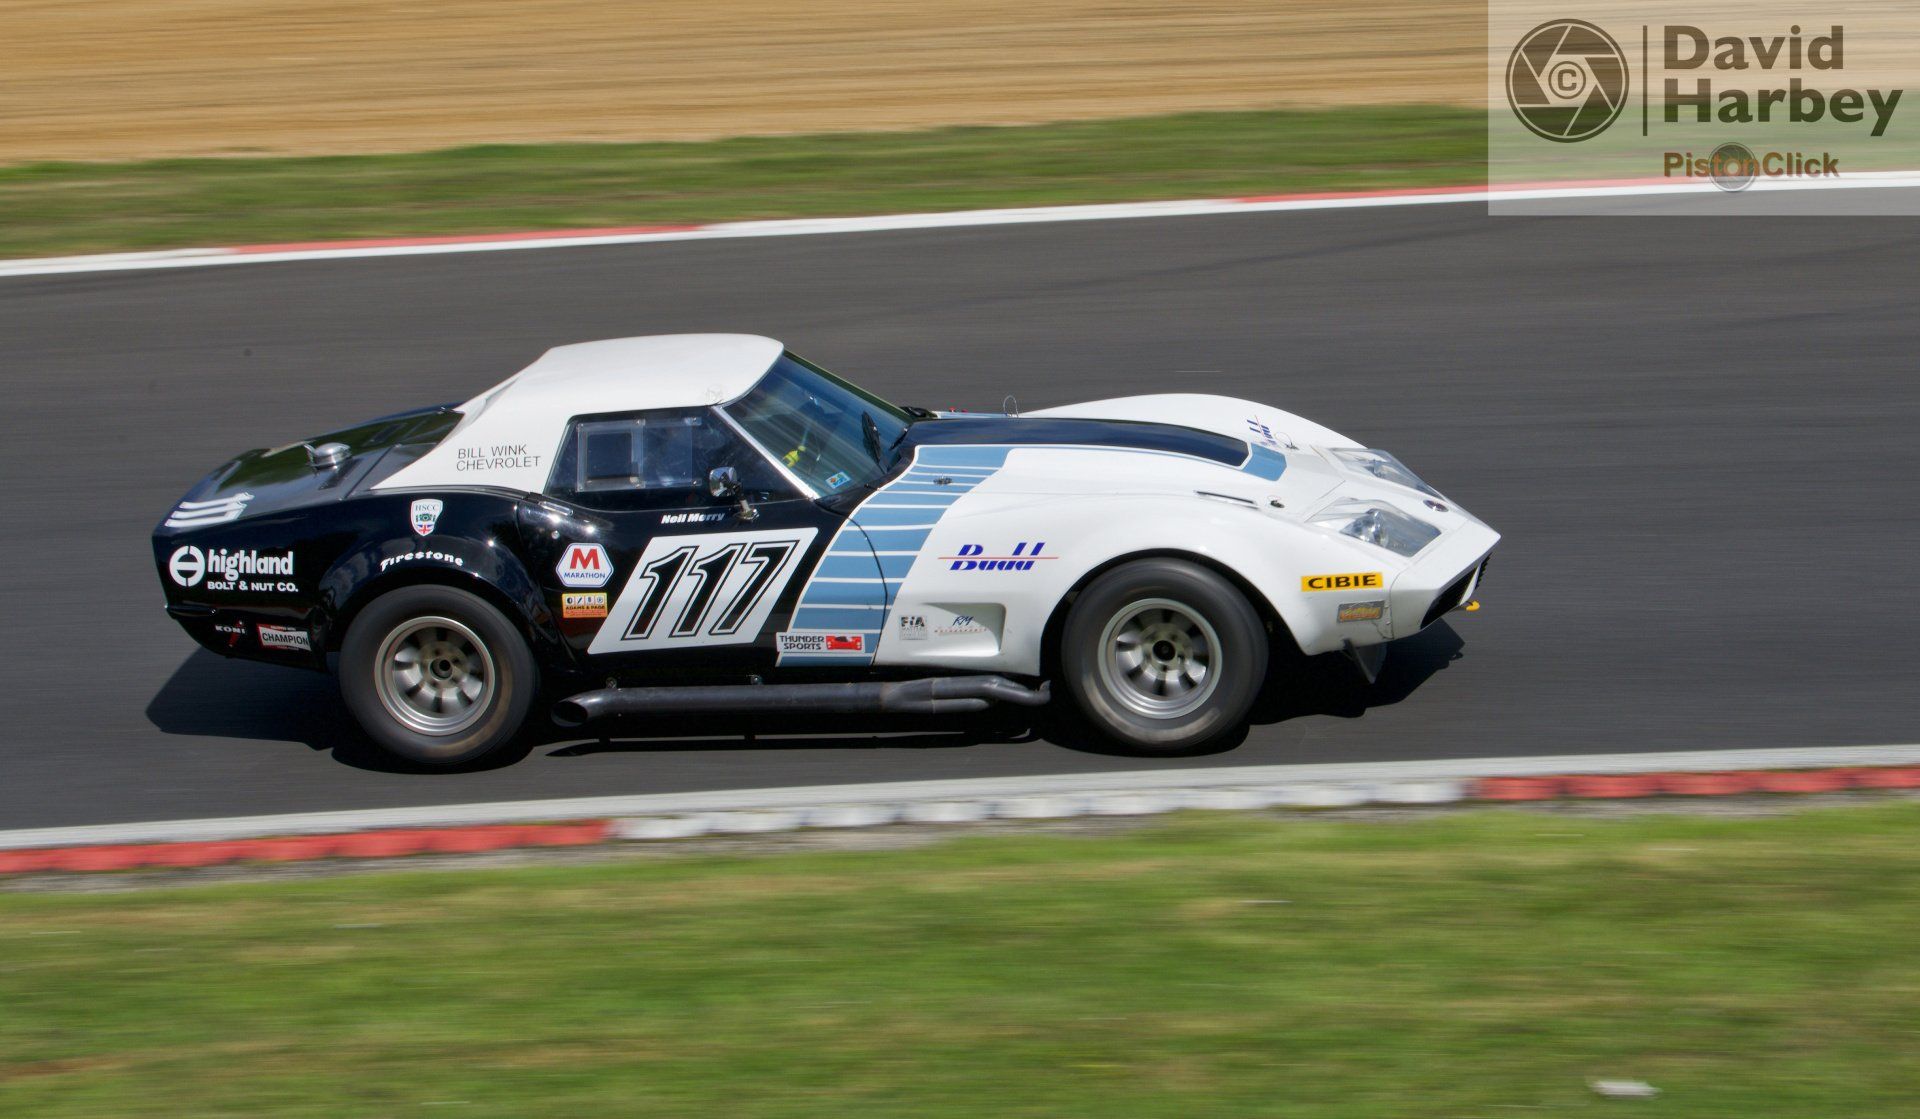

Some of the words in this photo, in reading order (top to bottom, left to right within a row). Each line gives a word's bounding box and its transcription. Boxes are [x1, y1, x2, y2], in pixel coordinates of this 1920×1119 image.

[458, 447, 486, 459] BILL
[491, 444, 527, 457] WINK
[456, 456, 541, 472] CHEVROLET
[415, 503, 440, 512] HSCC
[661, 513, 687, 524] Neil
[687, 512, 725, 522] Merry
[207, 548, 293, 582] highland
[380, 550, 464, 572] Firestone
[570, 548, 600, 570] M
[207, 581, 236, 590] BOLT
[239, 581, 248, 590] &
[251, 582, 274, 592] NUT
[277, 582, 299, 592] CO.
[1308, 574, 1376, 589] CIBIE
[620, 539, 800, 641] 117
[952, 615, 974, 627] RM
[215, 625, 246, 634] KONI
[262, 632, 309, 646] CHAMPION
[780, 635, 825, 644] THUNDER
